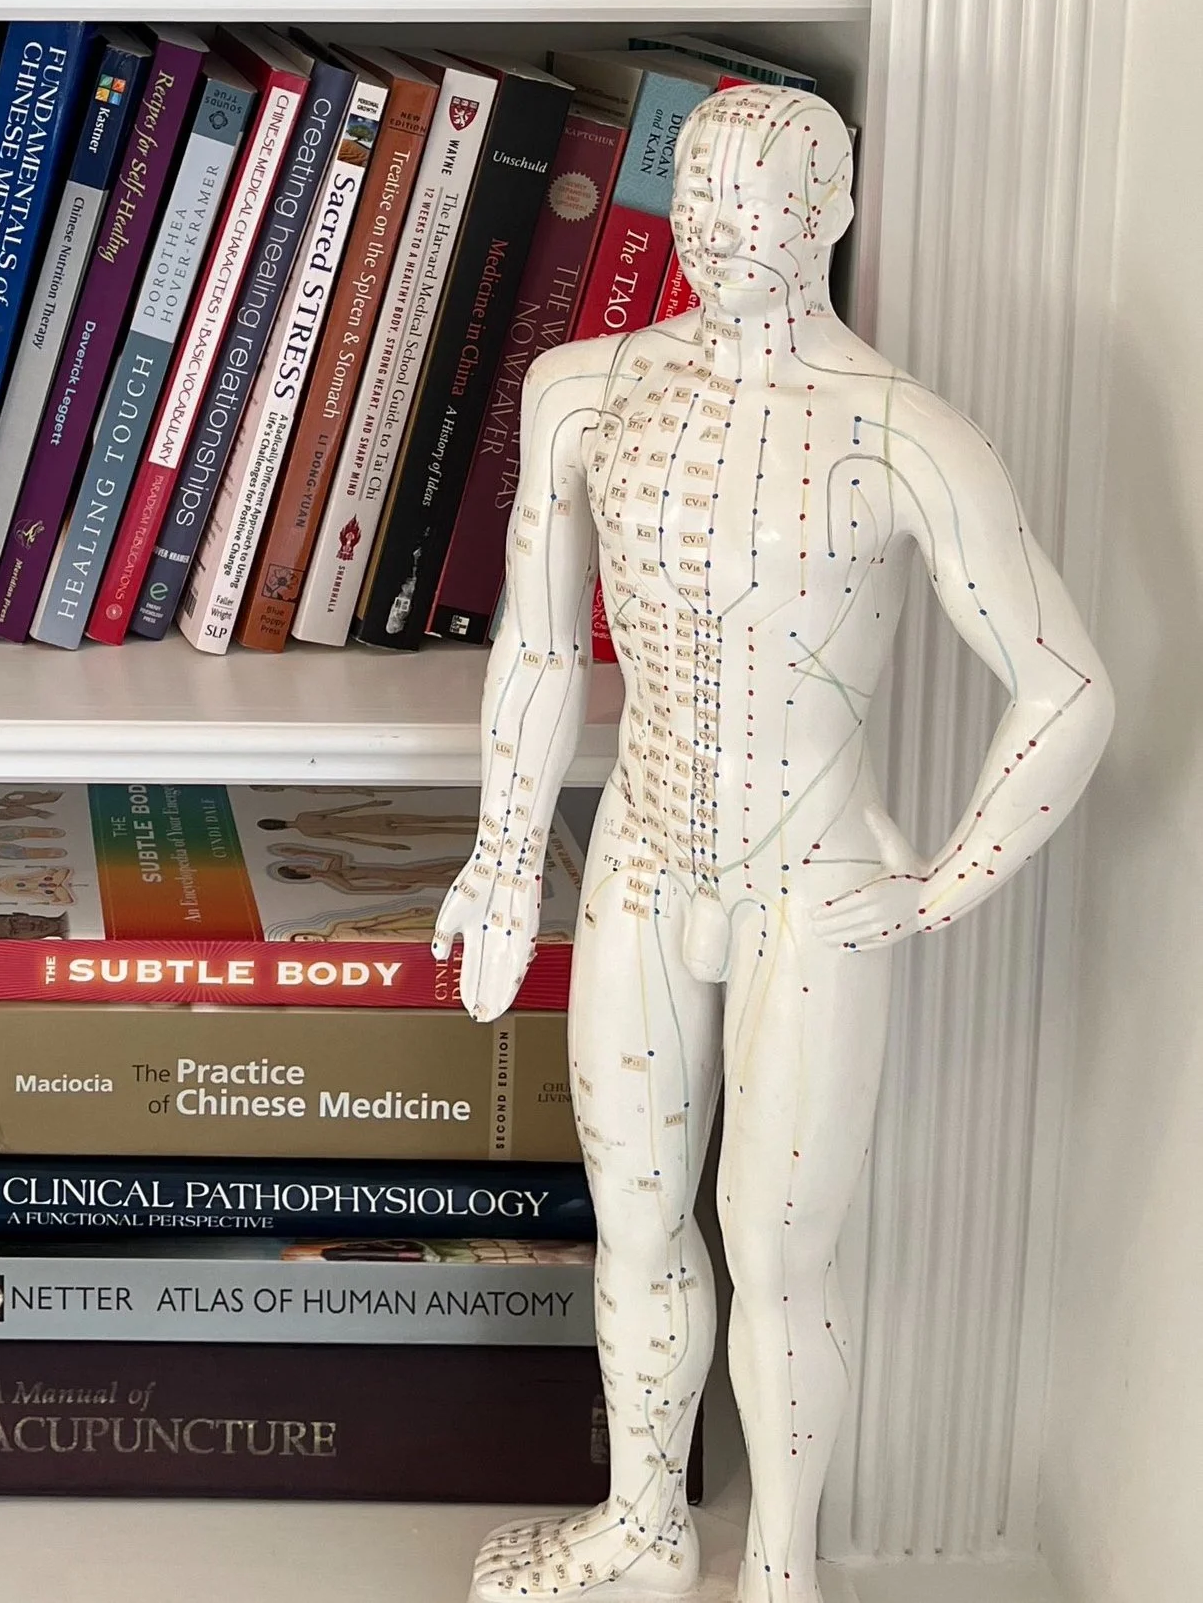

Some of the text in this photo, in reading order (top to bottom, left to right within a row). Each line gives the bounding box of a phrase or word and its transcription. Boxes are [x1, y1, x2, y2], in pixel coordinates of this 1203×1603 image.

[88, 106, 110, 153] Kastner
[639, 108, 664, 174] and KAIN
[655, 112, 683, 179] DUNCAN
[441, 139, 460, 175] WAYNE
[492, 149, 548, 173] Unschuld
[273, 172, 355, 399] Sacred STRESS
[49, 319, 96, 445] Daverick Leggett
[56, 353, 154, 619] HEALING TOUCH
[204, 623, 228, 638] SLP
[45, 956, 402, 985] THE SUBTLE BODY
[15, 1073, 112, 1092] Maciocia
[131, 1057, 305, 1084] The Practice
[148, 1087, 471, 1121] of Chinese Medicine
[2, 1176, 548, 1217] CLINICAL PATHOPHYSIOLOGY
[11, 1285, 133, 1311] NETTER
[156, 1286, 243, 1313] ATLAS
[253, 1287, 292, 1313] OF
[303, 1288, 416, 1315] HUMAN
[424, 1290, 573, 1316] ANATOMY
